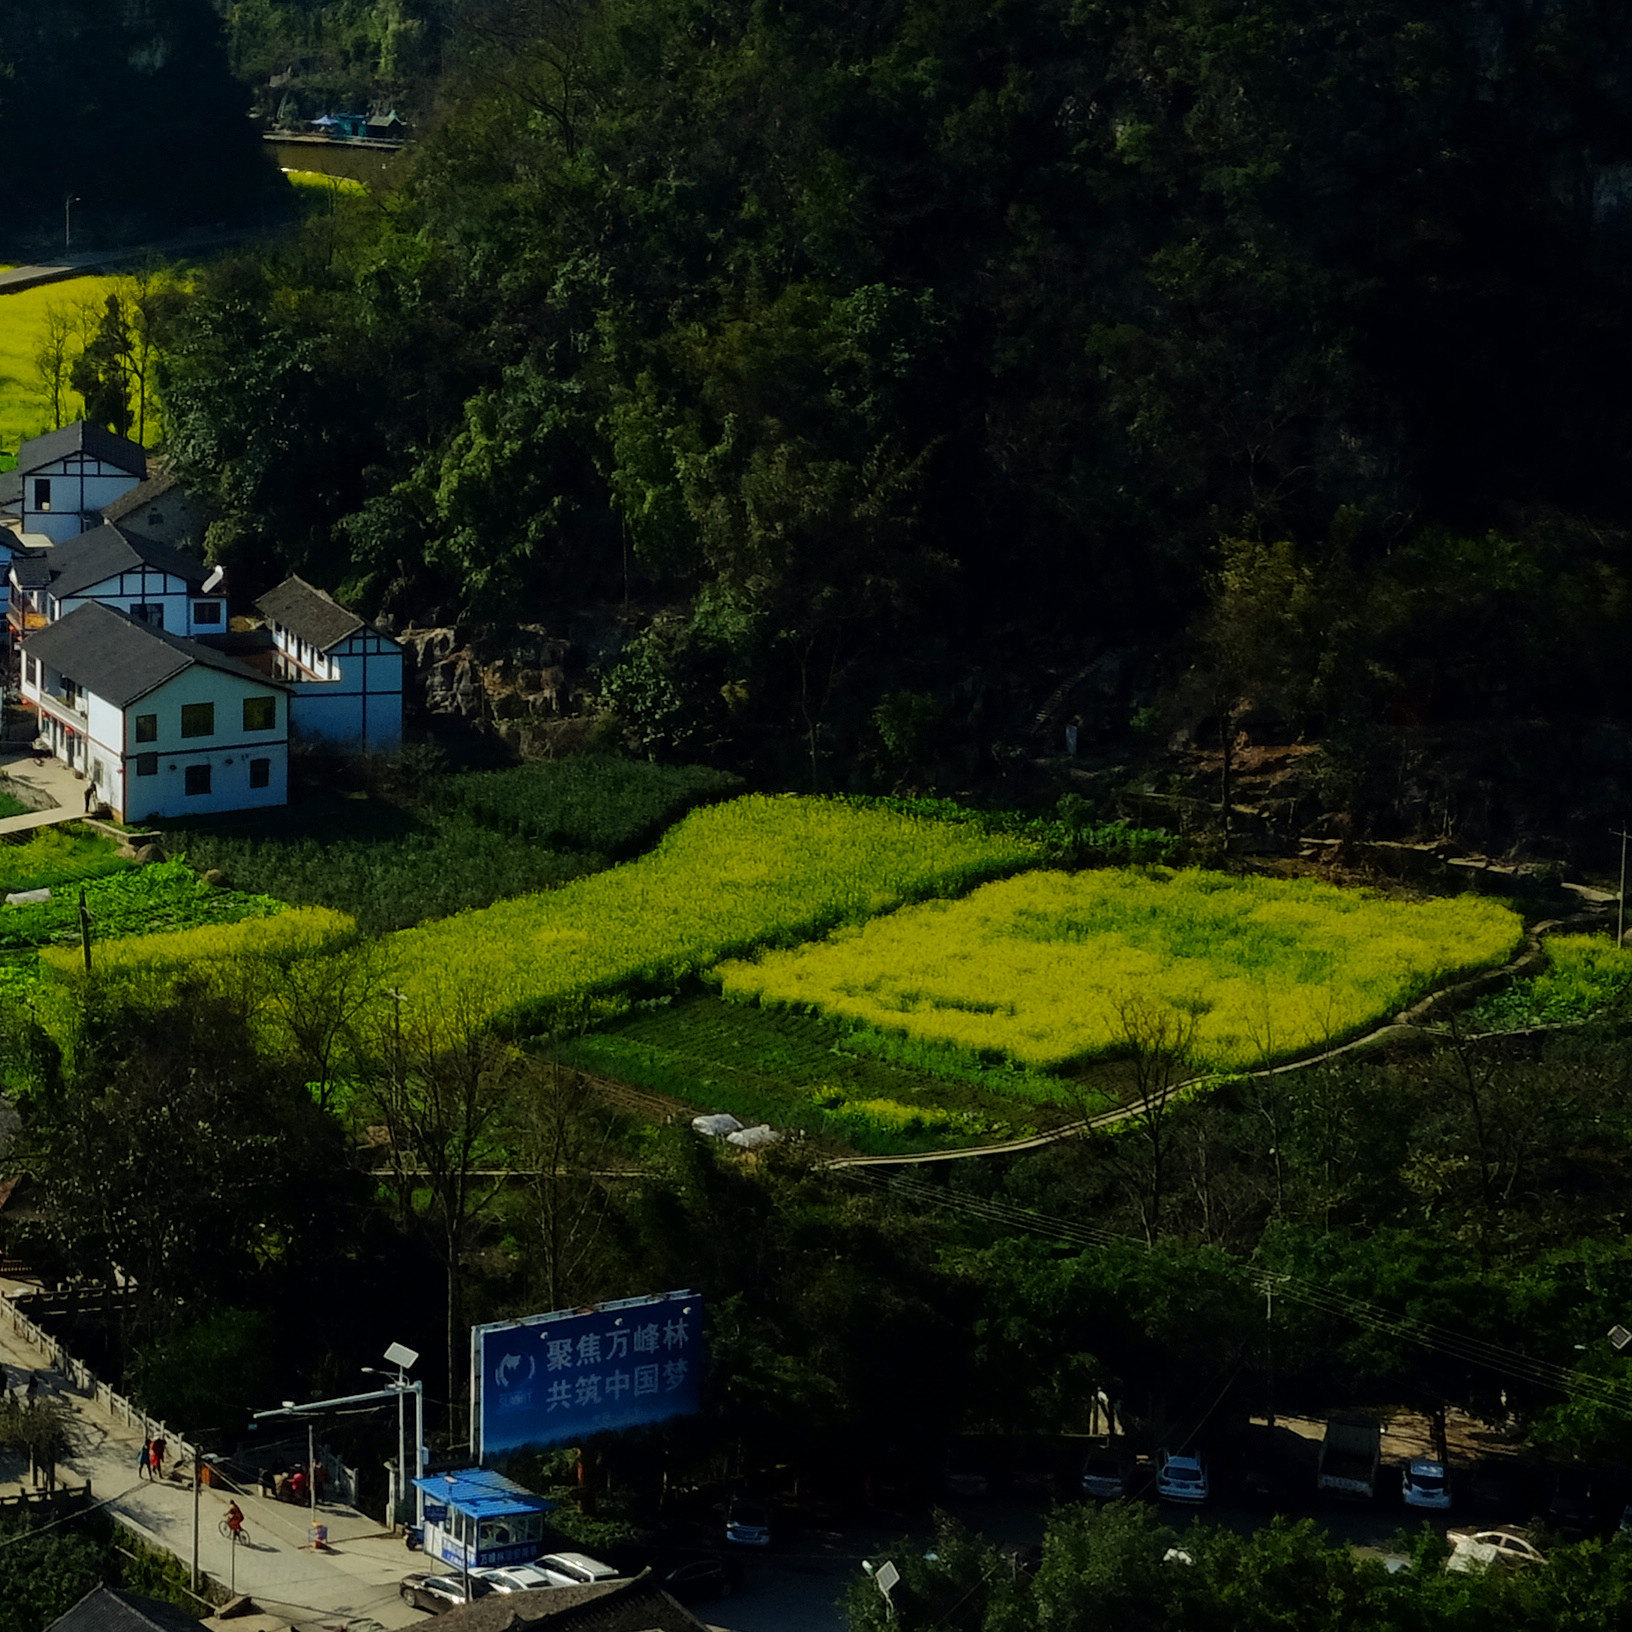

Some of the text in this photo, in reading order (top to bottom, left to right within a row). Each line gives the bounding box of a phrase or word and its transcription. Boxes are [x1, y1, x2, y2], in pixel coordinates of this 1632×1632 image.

[546, 1317, 689, 1372] 聚焦万峰林
[545, 1357, 689, 1413] 共筑中国梦
